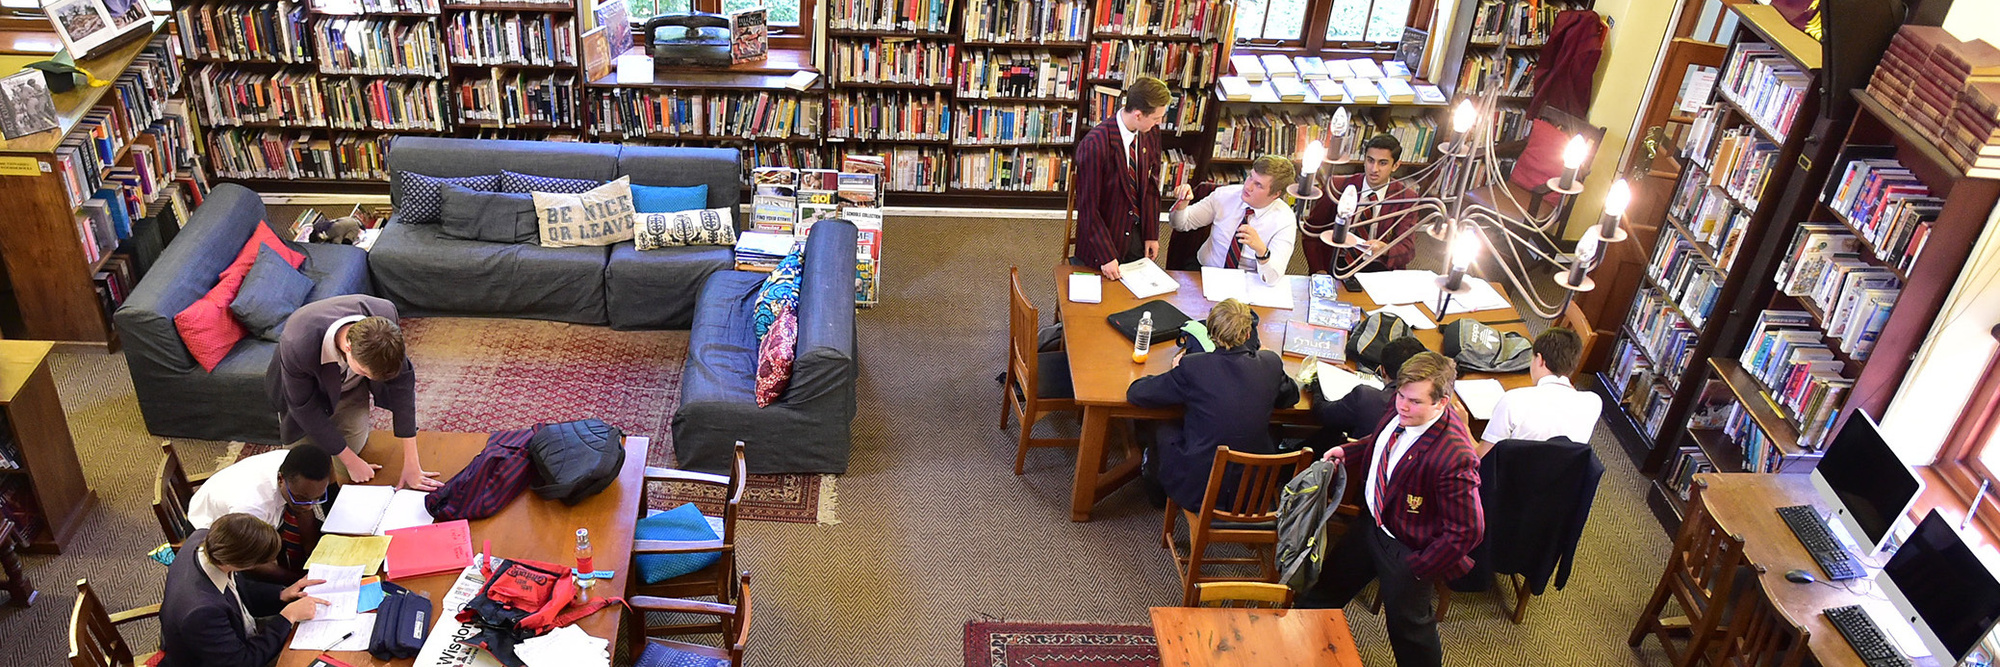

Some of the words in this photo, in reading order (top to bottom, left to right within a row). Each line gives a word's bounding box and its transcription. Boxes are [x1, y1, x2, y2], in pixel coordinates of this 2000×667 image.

[546, 206, 573, 225] BE
[584, 194, 631, 221] NICE
[811, 193, 831, 204] go!
[549, 226, 573, 242] OR
[579, 213, 634, 240] LEAVE
[1471, 323, 1480, 343] adidas
